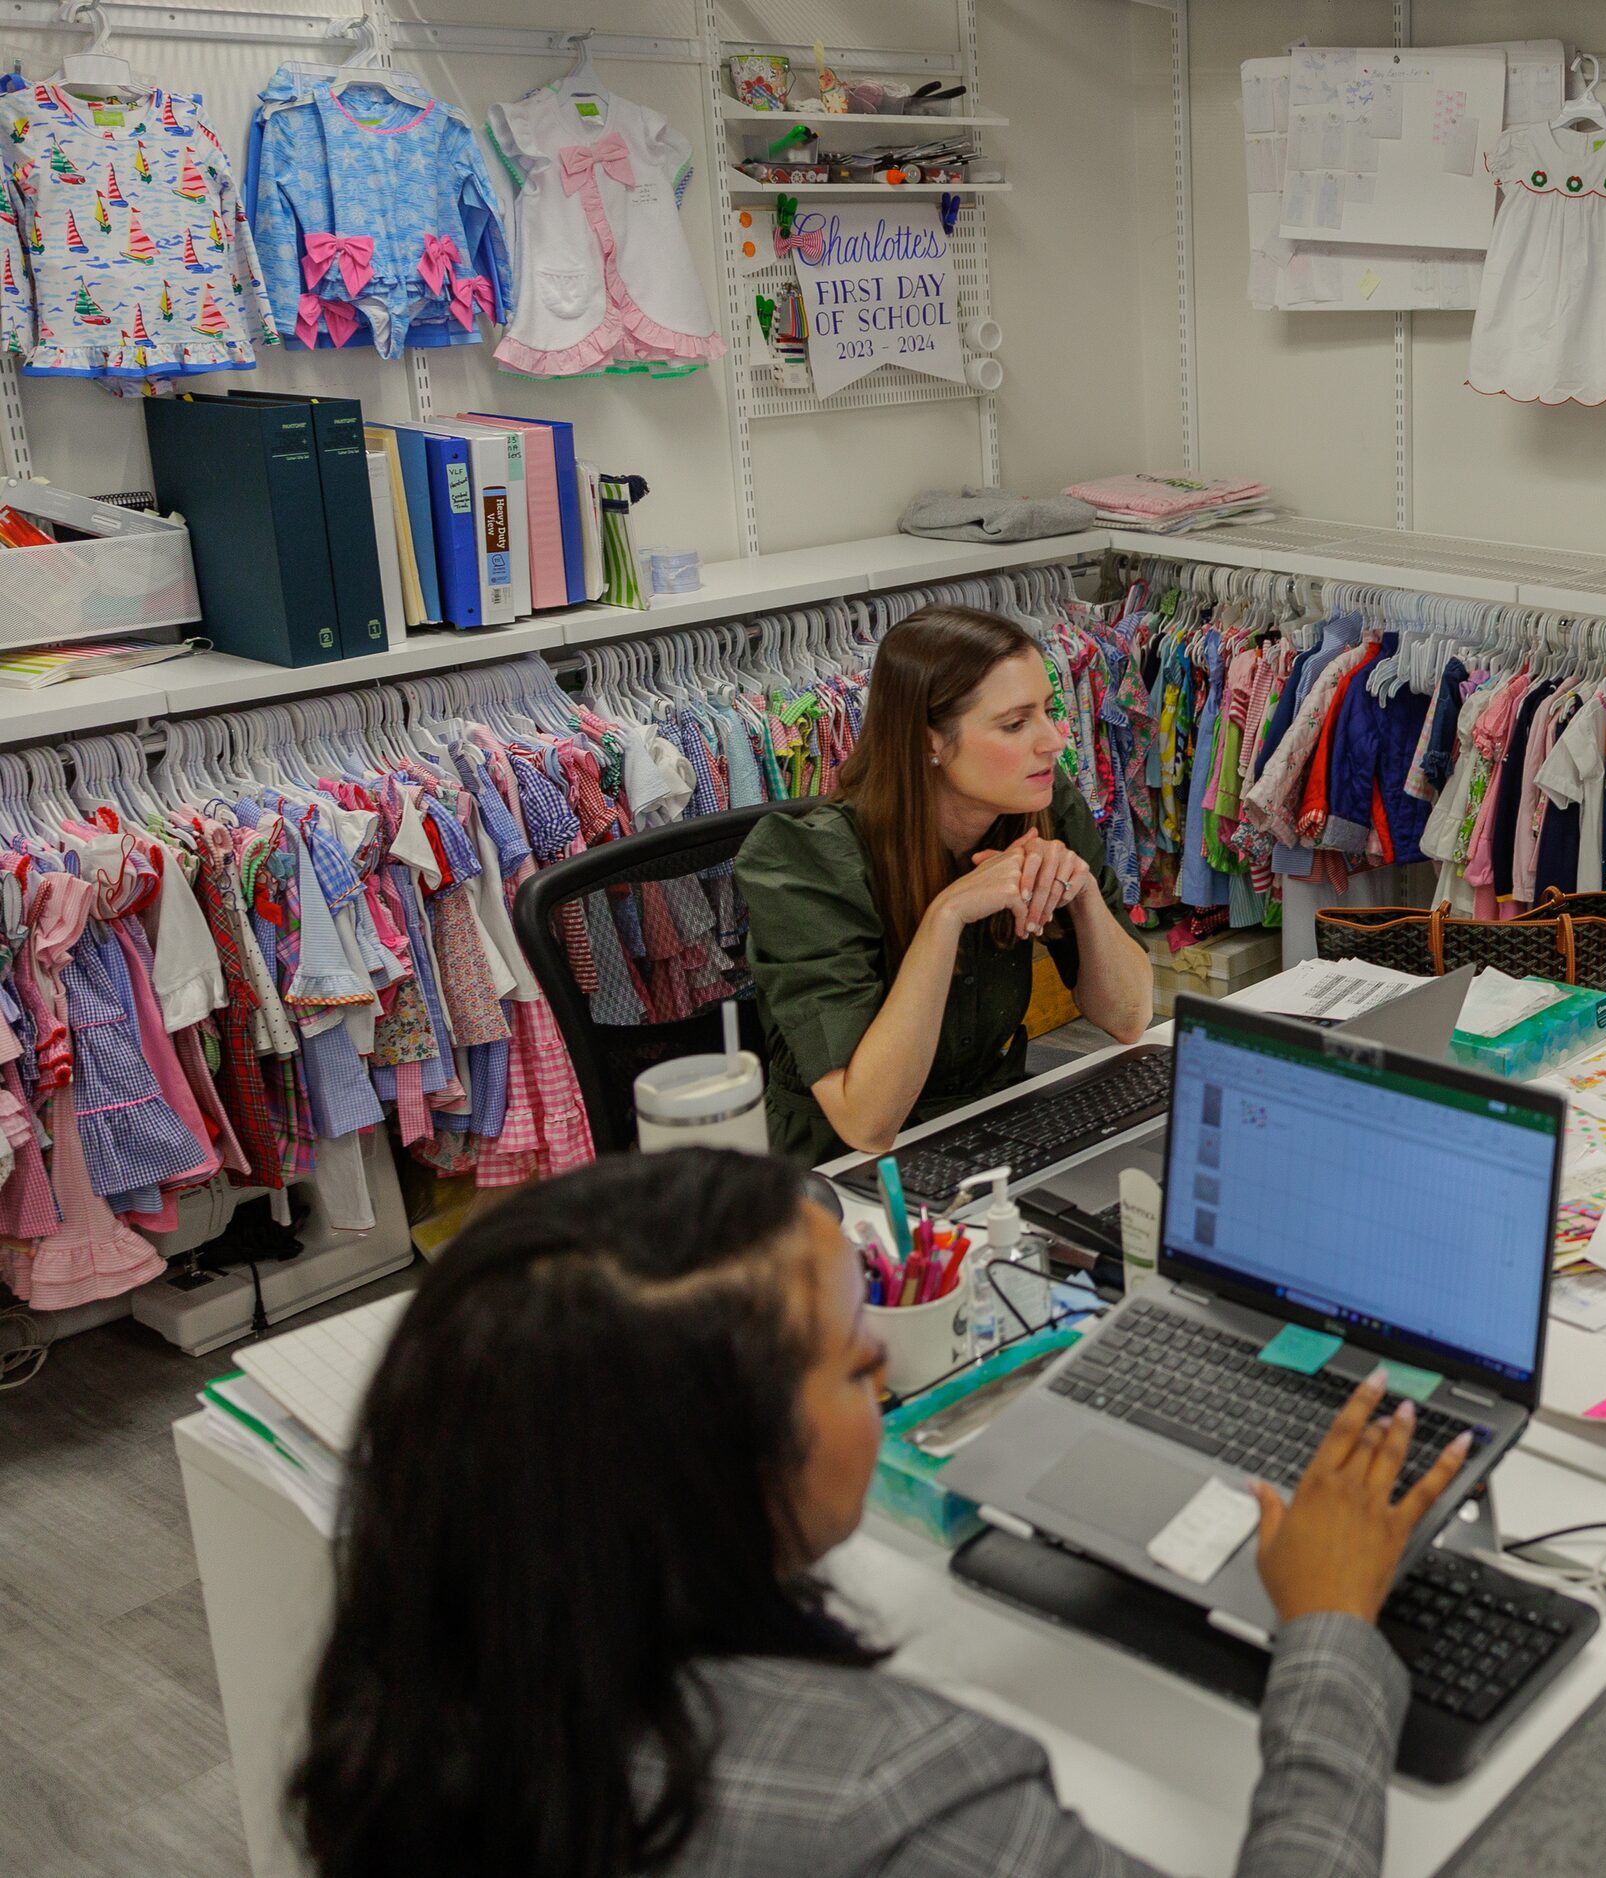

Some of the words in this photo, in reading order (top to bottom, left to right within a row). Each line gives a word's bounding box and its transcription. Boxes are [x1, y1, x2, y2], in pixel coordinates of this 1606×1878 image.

[794, 213, 947, 266] Charlotte's
[815, 277, 883, 305] FIRST
[897, 273, 946, 299] DAY
[815, 310, 845, 336] OF
[858, 302, 951, 333] SCHOOL
[837, 340, 874, 360] 2023
[897, 335, 935, 353] 2024
[487, 513, 495, 536] View
[496, 498, 505, 526] Heavy
[497, 527, 506, 549] Duty
[323, 634, 330, 642] 2
